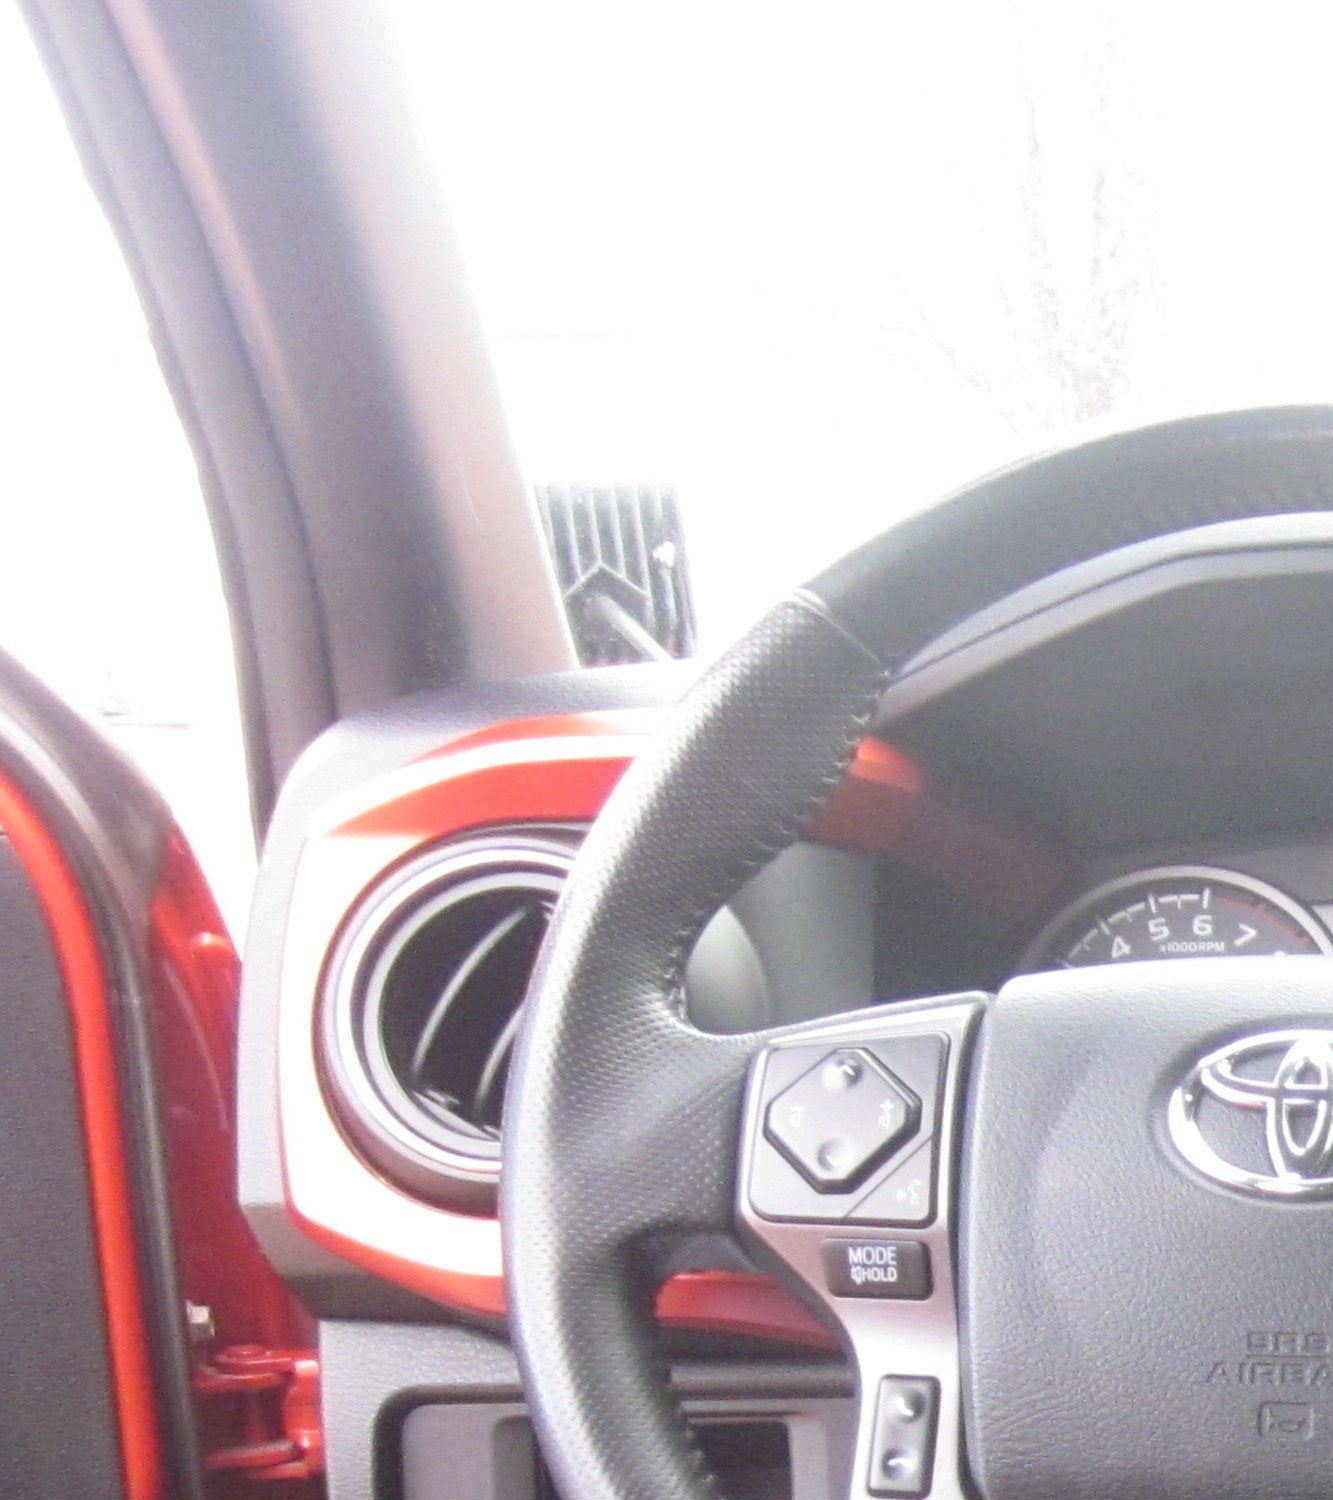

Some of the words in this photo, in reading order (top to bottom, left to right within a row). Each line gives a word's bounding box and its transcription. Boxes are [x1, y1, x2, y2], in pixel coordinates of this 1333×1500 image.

[1148, 917, 1170, 941] 5
[1192, 914, 1214, 936] 6
[848, 1246, 897, 1265] MODE
[861, 1267, 898, 1282] HOLD
